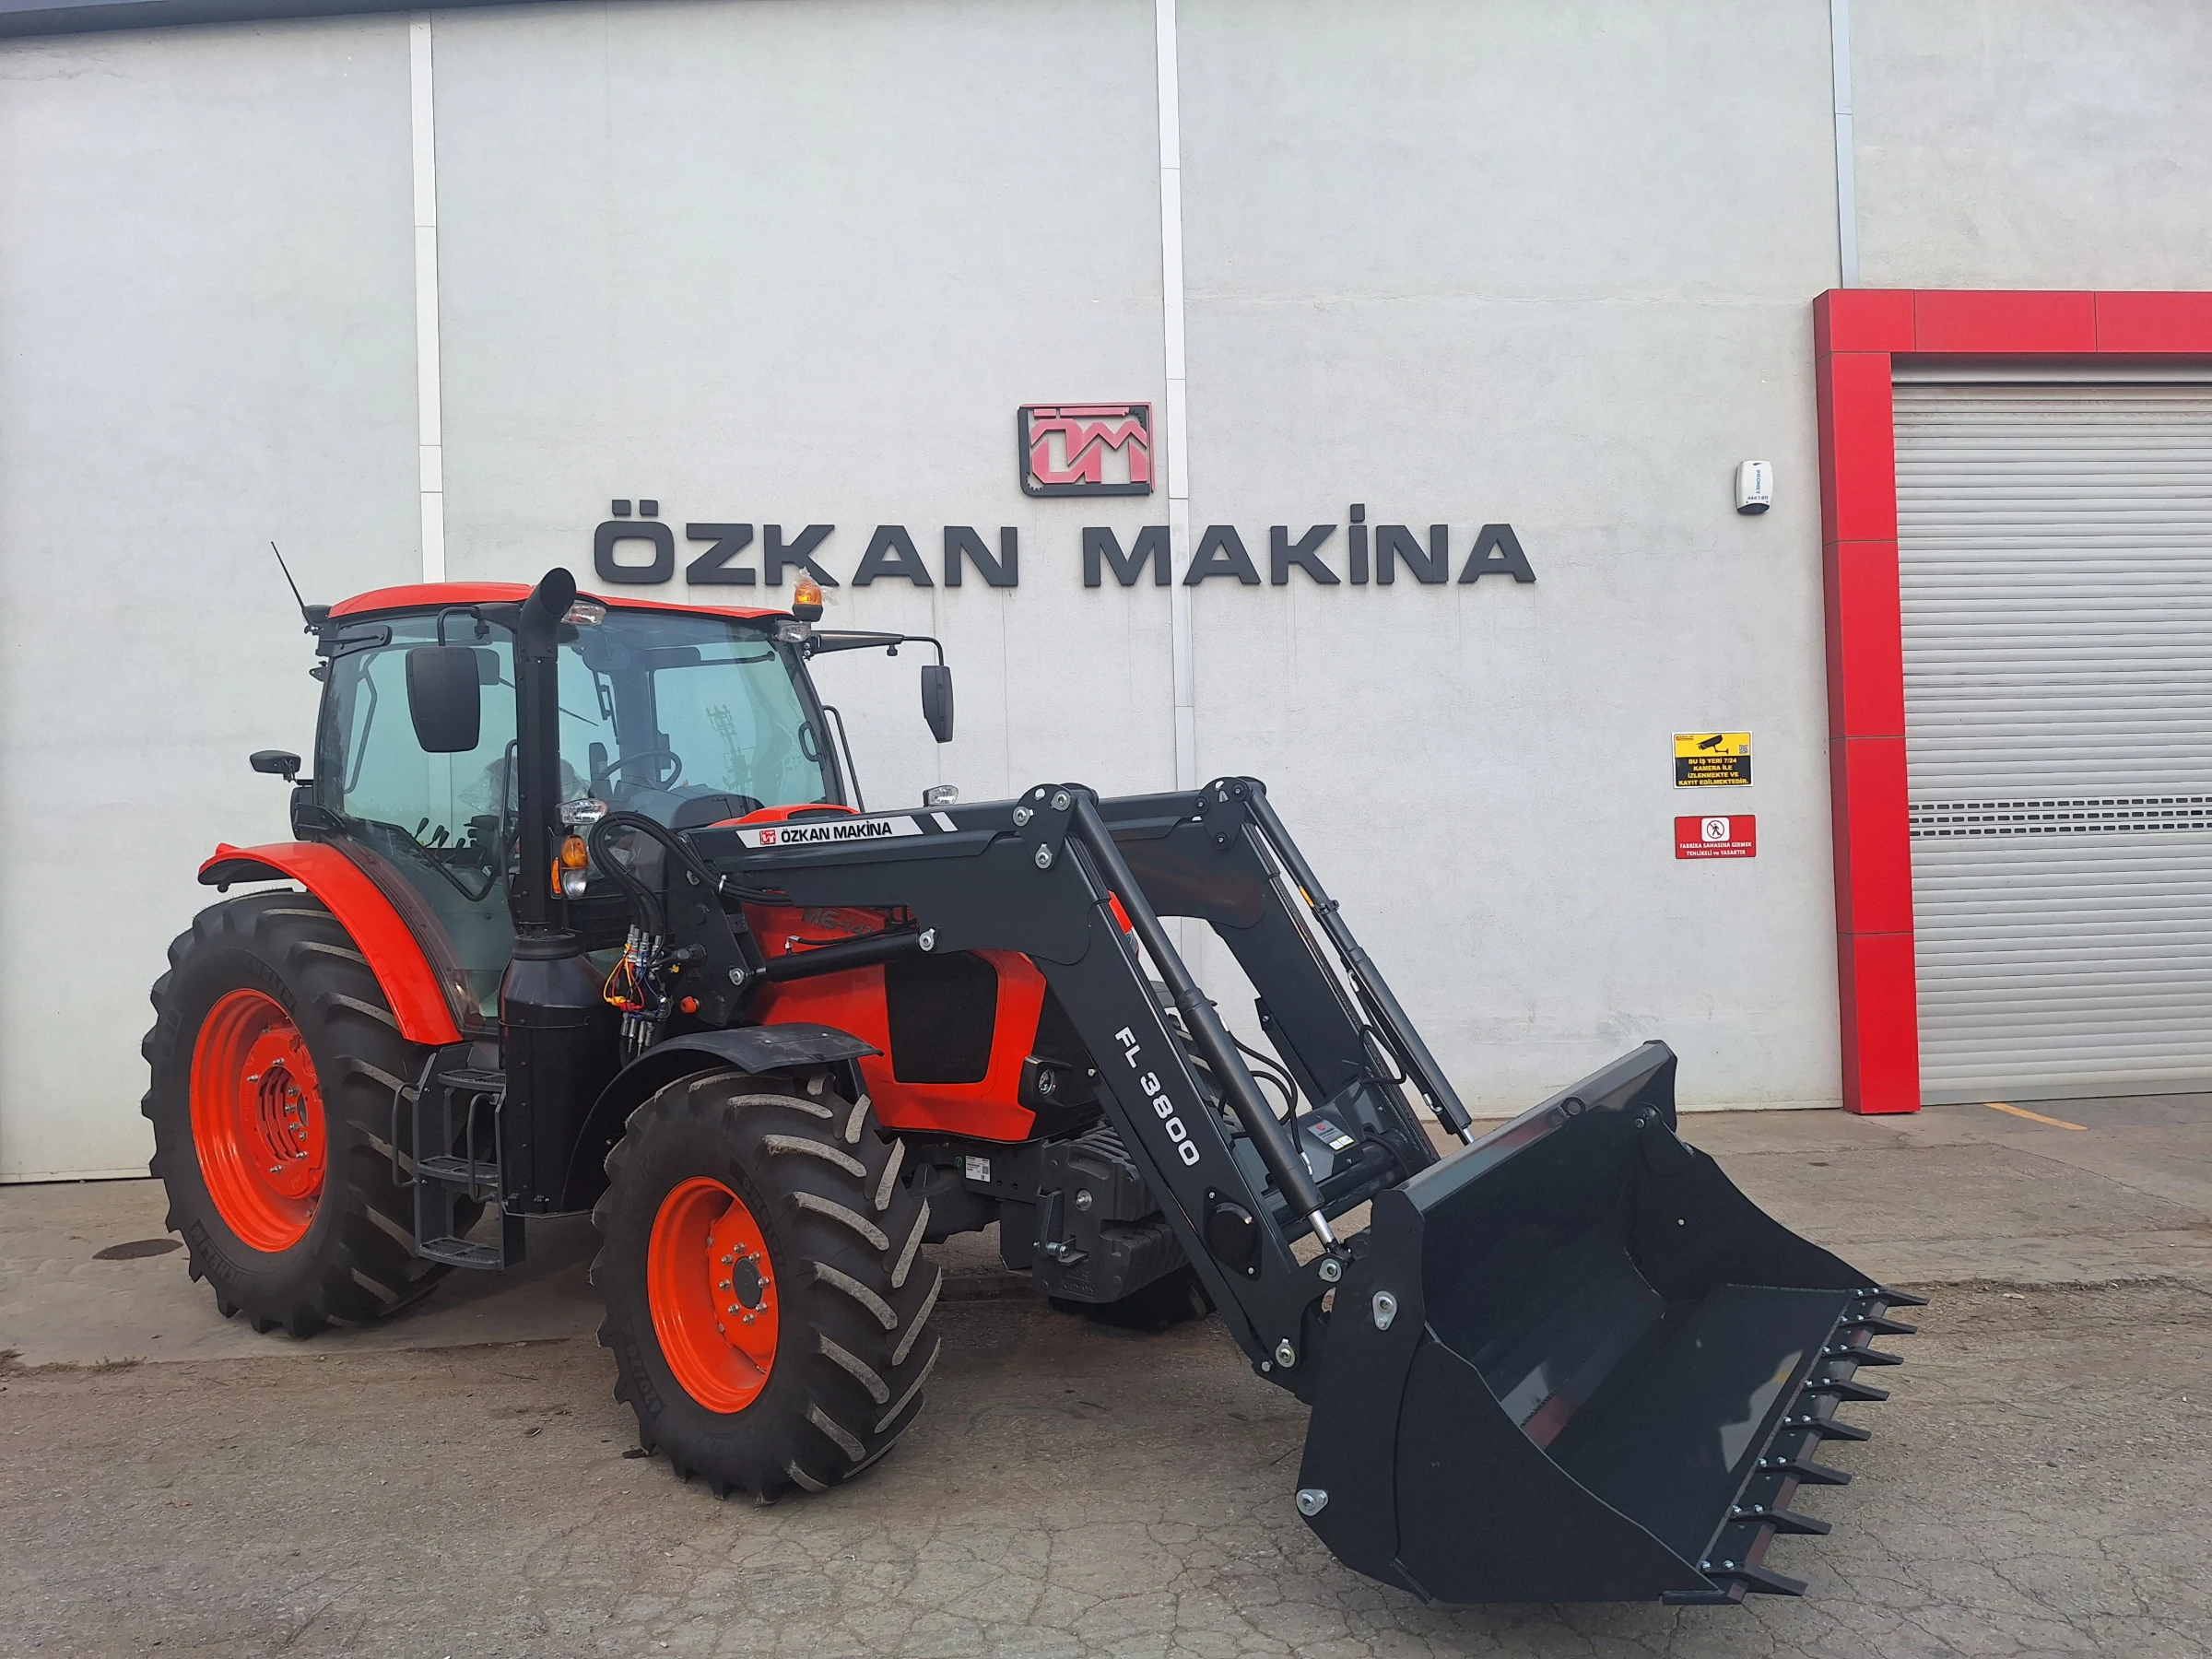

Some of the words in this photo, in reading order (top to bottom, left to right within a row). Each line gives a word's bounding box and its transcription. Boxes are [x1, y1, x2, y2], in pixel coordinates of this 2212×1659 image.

[594, 499, 1018, 587] ÖZKAN
[1082, 503, 1537, 588] MAKİNA
[781, 827, 830, 843] ÖZKAN
[833, 820, 893, 840] MAKİNA
[1114, 1026, 1141, 1069] FL
[1140, 1071, 1200, 1167] 3800
